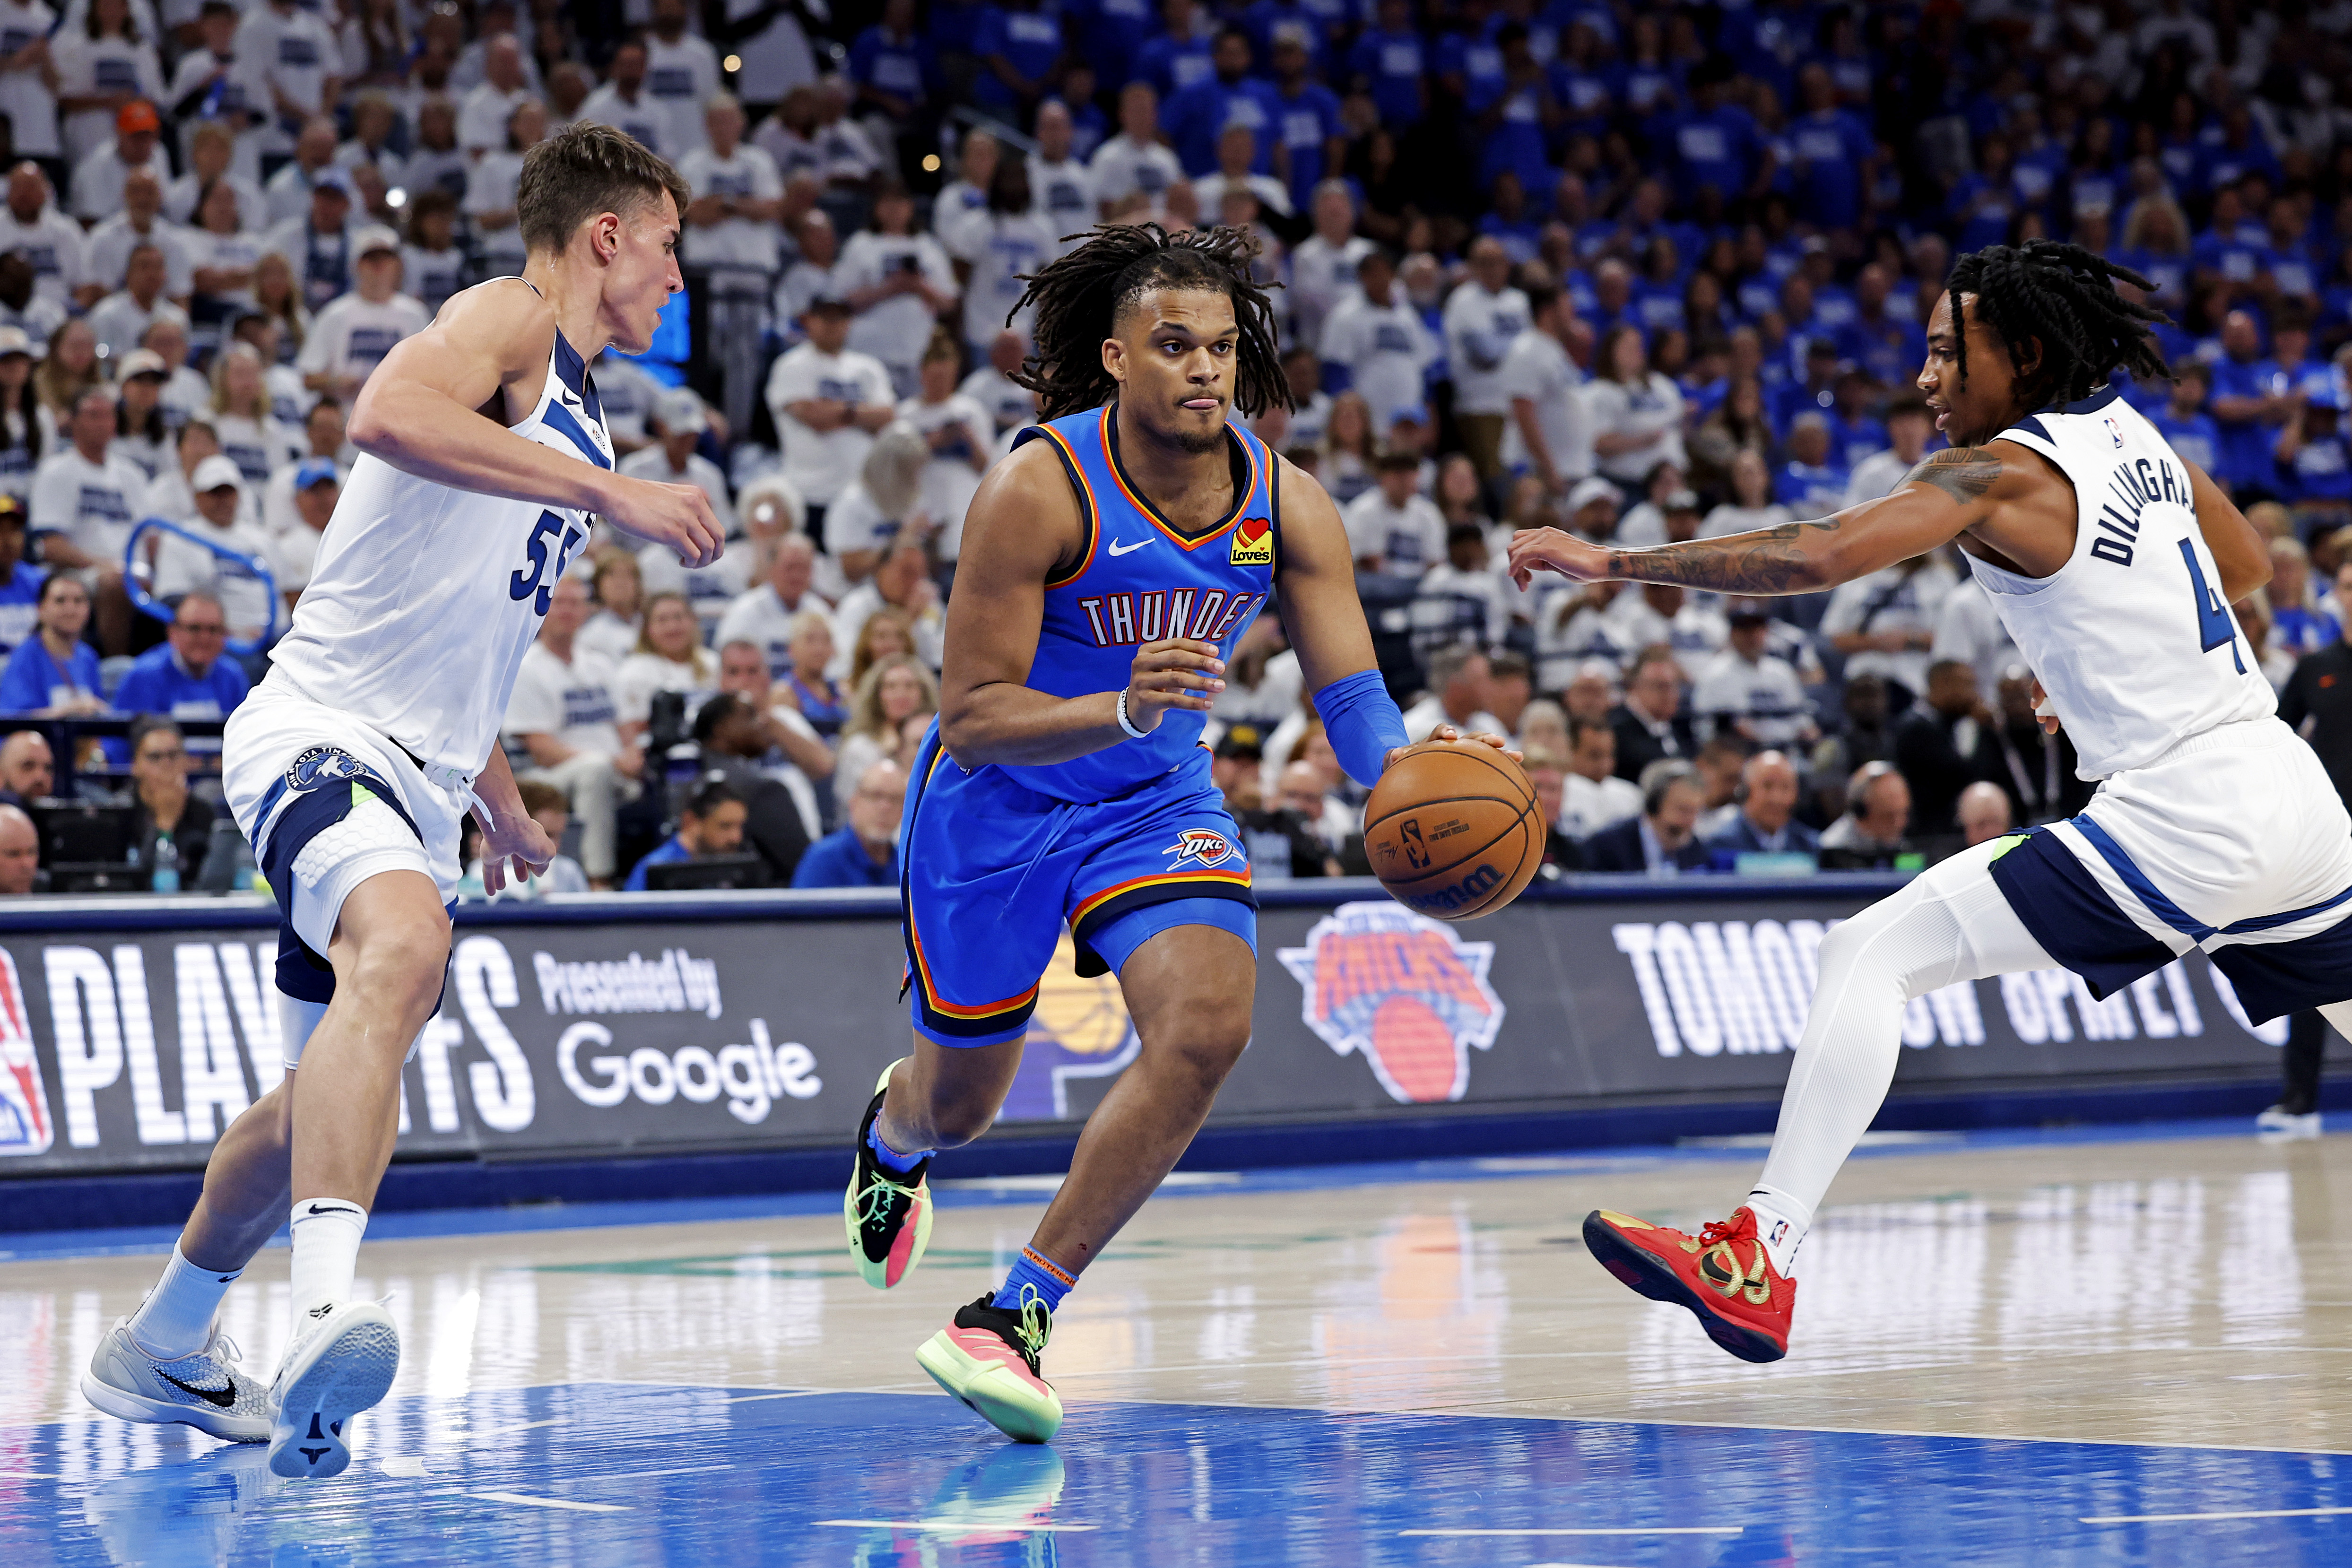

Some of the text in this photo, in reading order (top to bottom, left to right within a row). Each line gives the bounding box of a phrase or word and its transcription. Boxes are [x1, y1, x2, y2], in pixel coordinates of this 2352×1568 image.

[509, 509, 582, 617] 55
[2090, 458, 2196, 567] DILLINGHA
[1078, 587, 1266, 648] THUNDER
[2177, 537, 2248, 676] 4
[288, 749, 318, 788] MINNSOTA
[1181, 838, 1224, 858] OKC
[532, 947, 723, 1020] Presented by
[1611, 918, 1986, 1057] TOMOR
[43, 934, 536, 1147] PLAYFS
[556, 1017, 822, 1124] Google
